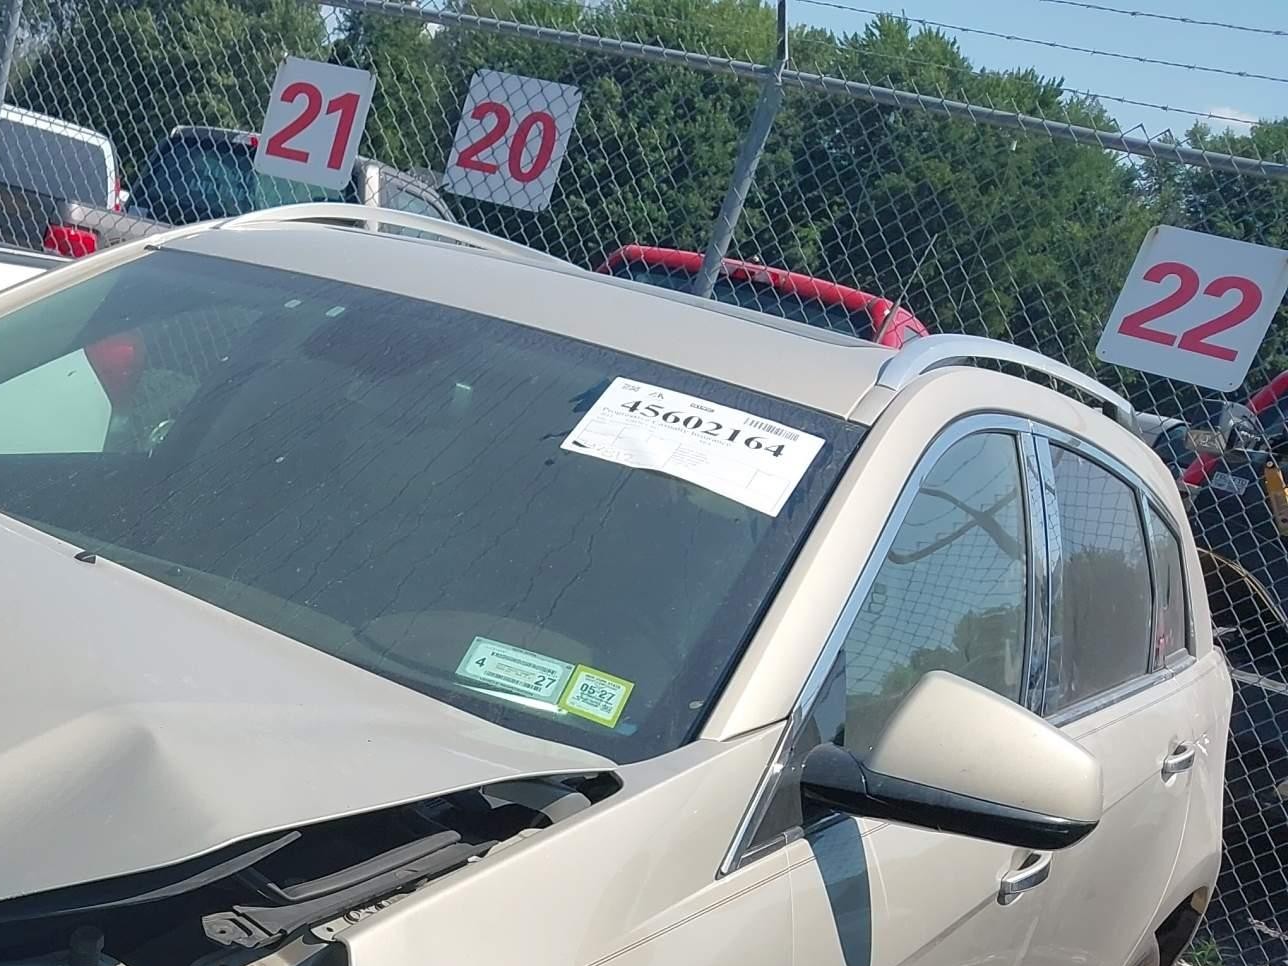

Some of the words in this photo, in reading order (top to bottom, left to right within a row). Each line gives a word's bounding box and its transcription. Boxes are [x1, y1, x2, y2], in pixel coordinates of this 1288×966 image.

[266, 82, 359, 169] 21
[457, 101, 556, 183] 20
[1118, 262, 1262, 361] 22
[621, 400, 786, 459] 45602164
[475, 657, 487, 667] 4
[534, 675, 557, 689] 27
